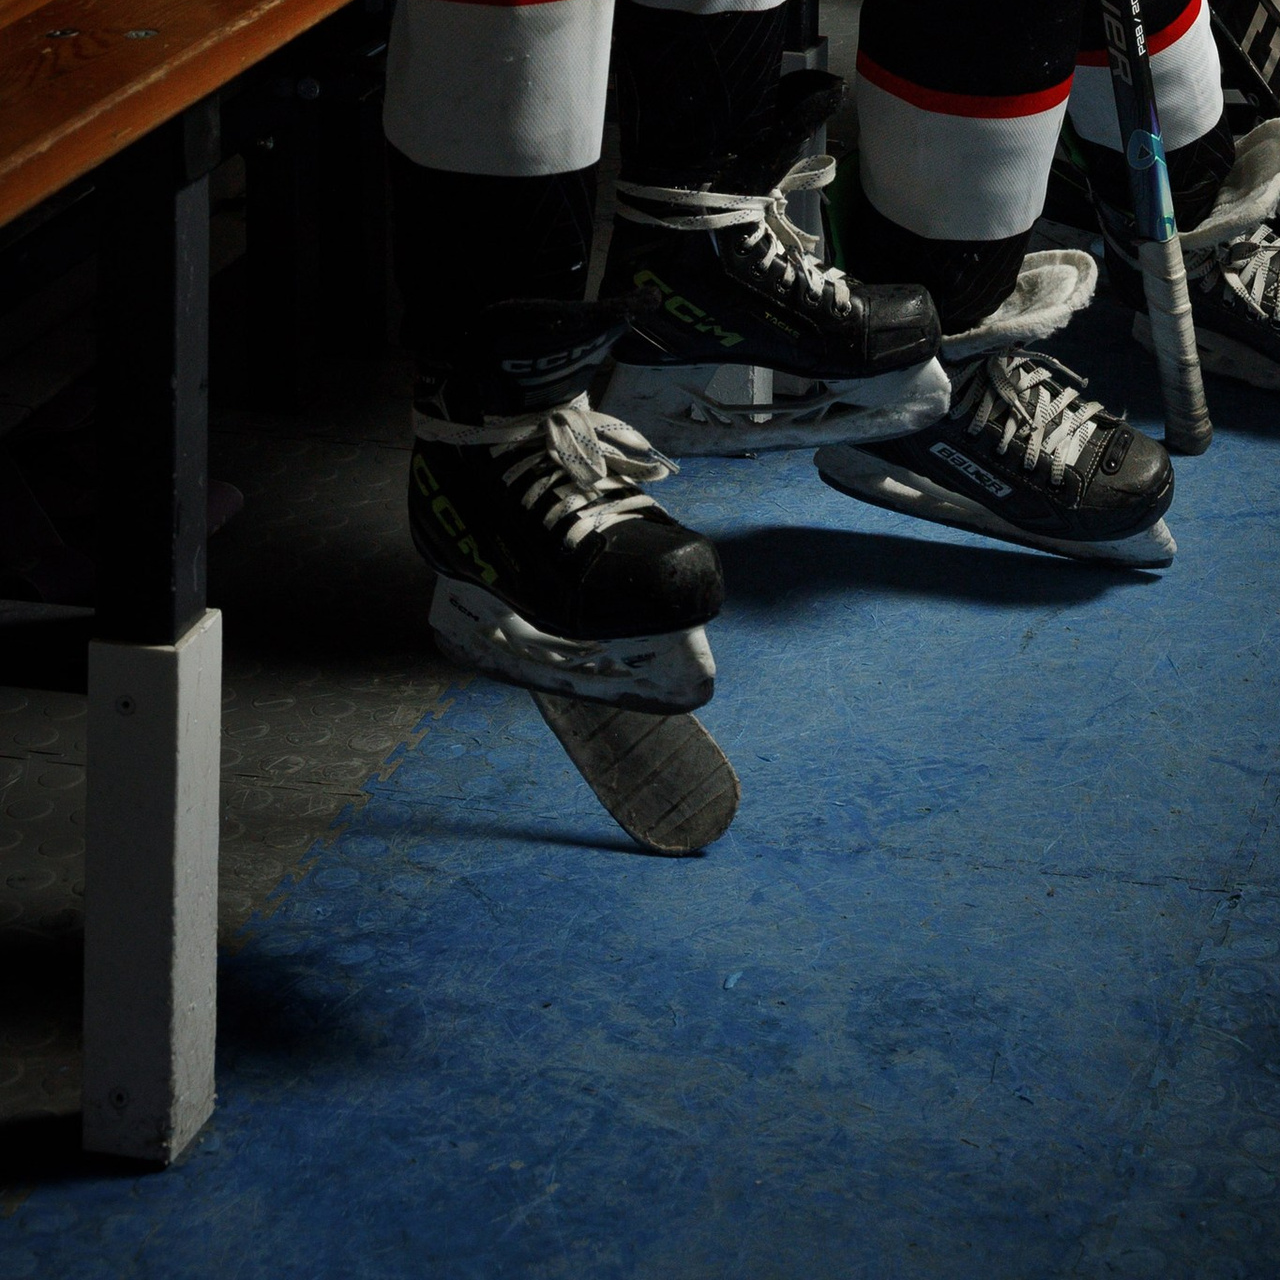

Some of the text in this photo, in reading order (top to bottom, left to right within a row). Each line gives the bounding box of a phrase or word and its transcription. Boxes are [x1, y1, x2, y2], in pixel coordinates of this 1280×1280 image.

[1135, 24, 1147, 57] P28
[632, 268, 746, 348] CCM
[937, 447, 1004, 494] BAUER
[411, 452, 499, 587] CCM
[448, 596, 481, 622] CCM
